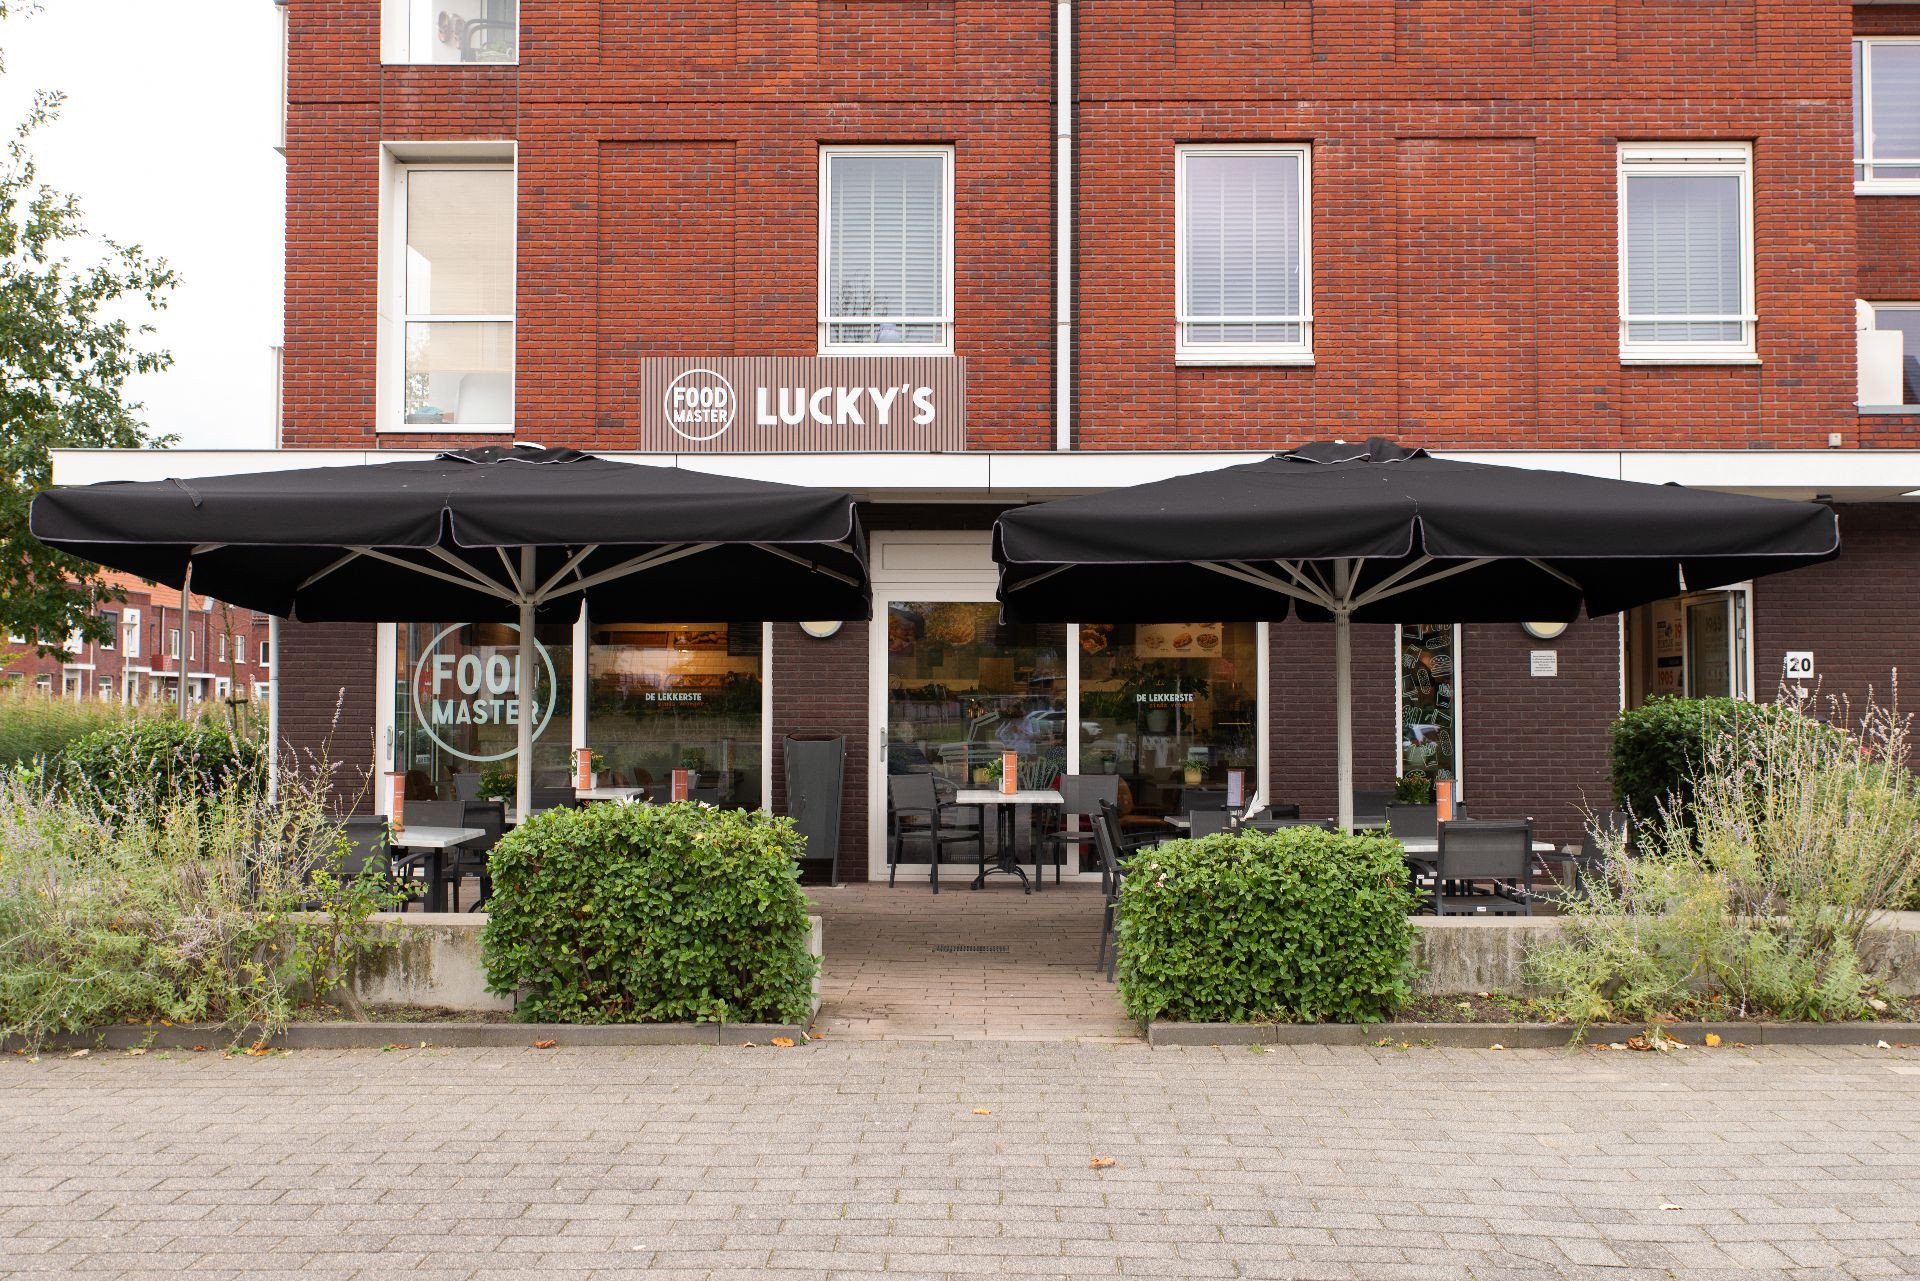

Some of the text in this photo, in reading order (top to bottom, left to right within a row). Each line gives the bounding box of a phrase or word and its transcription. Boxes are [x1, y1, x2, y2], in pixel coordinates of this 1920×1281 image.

[673, 387, 728, 408] FOOD
[757, 383, 936, 425] LUCKY'S
[673, 409, 728, 423] MASTER
[1789, 657, 1811, 672] 20
[432, 654, 520, 695] FOO
[645, 692, 702, 701] DE LEKKERSTE
[1136, 693, 1194, 702] DE LEKKERSTE
